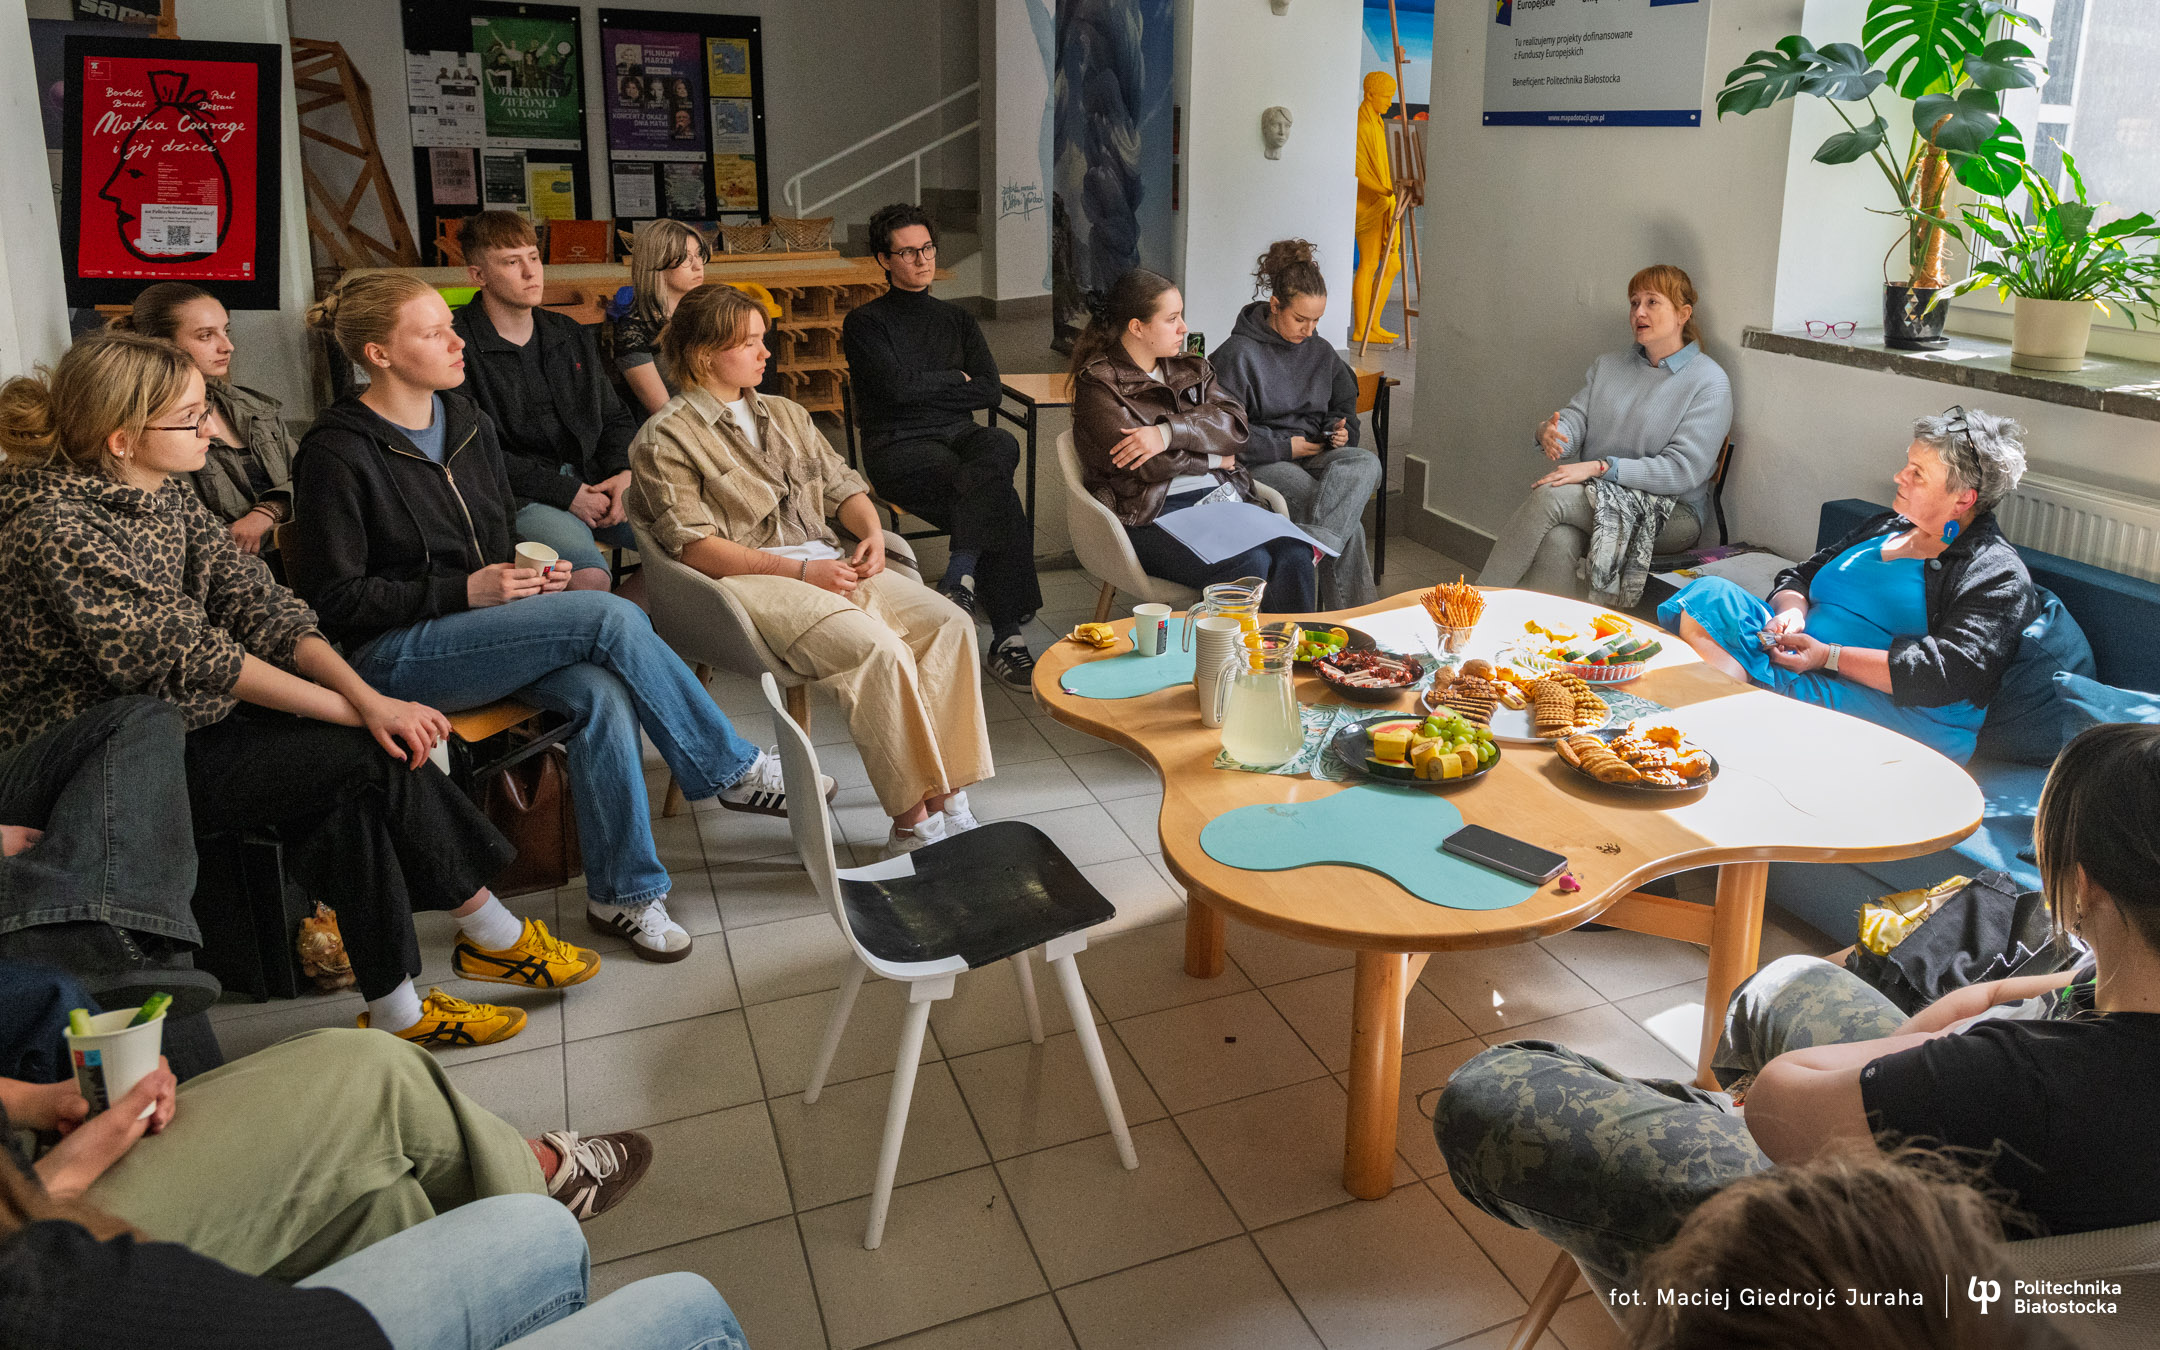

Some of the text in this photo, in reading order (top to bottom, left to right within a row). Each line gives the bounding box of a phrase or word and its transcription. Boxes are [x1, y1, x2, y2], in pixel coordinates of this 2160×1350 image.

[1515, 30, 1633, 48] Tu realizujemy projekty dofinansowane
[1518, 49, 1544, 60] Funduszy
[1545, 47, 1584, 58] Europejskich
[1512, 73, 1621, 88] Beneficjent: Politechnika Białostocka
[210, 90, 236, 100] Paul
[493, 86, 561, 98] ODKRYWCY
[500, 97, 557, 108] ZIELONEJ
[506, 108, 551, 119] WYSPY
[1548, 114, 1605, 123] www.mapadotacji.gov.pl
[93, 110, 247, 143] Matka Courage
[112, 139, 218, 160] i jej dzieci
